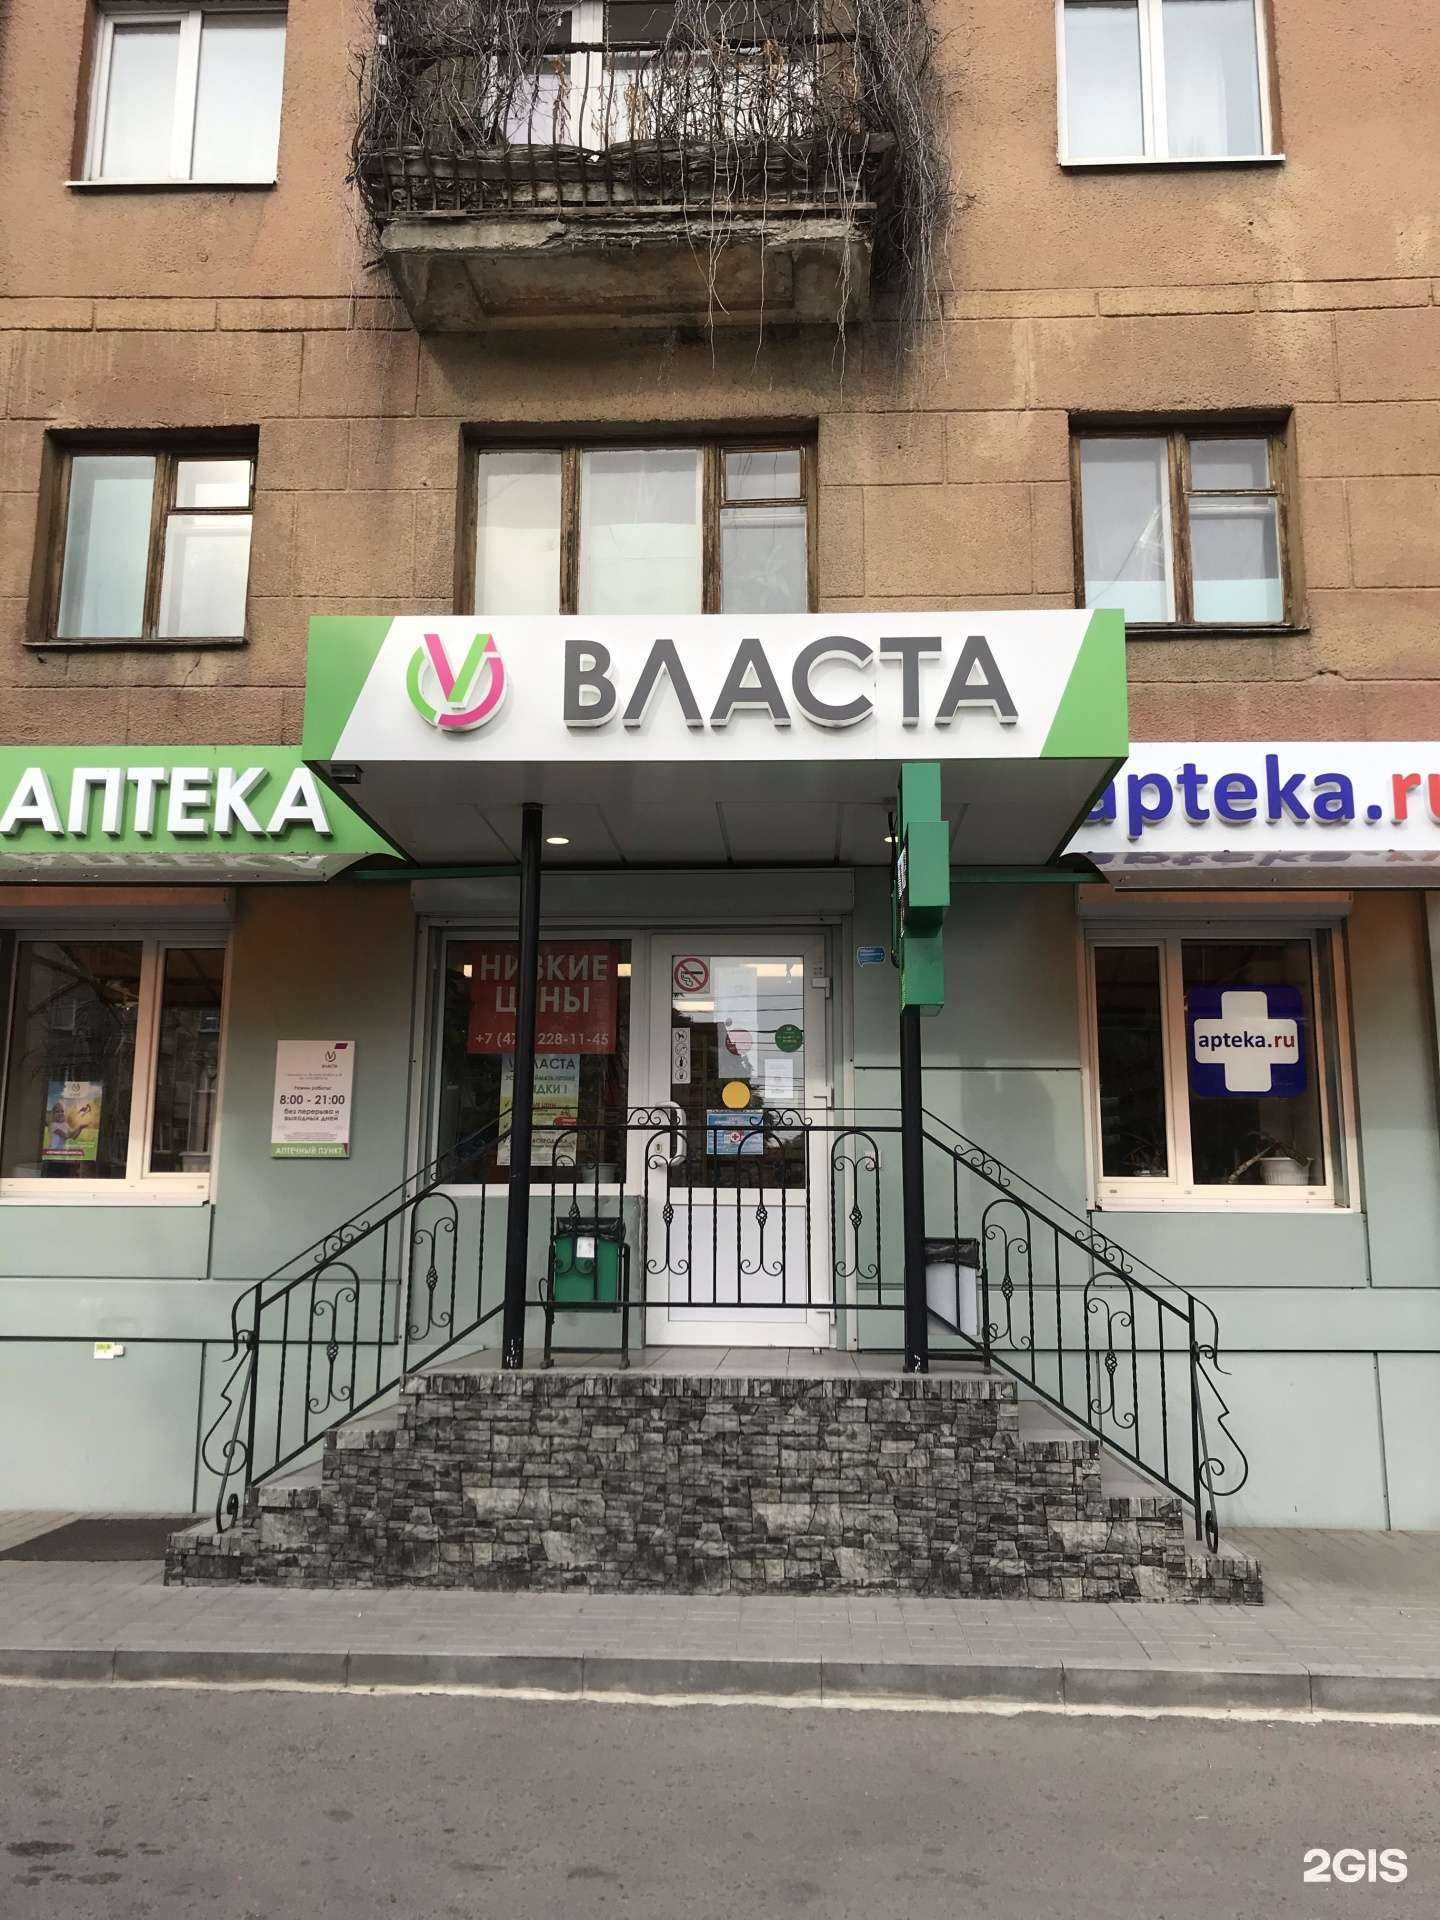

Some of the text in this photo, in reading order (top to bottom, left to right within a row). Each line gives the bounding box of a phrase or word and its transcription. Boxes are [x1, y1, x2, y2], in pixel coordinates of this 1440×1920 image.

[563, 635, 1019, 728] ВЛАСТА
[0, 767, 334, 838] АПТЕКА
[495, 986, 589, 1016] ЦНЫ
[476, 1033, 492, 1044] +7
[538, 1032, 609, 1045] 228-11-45
[1198, 1031, 1295, 1051] apteka.ru
[534, 1058, 575, 1069] АСТА
[280, 1095, 303, 1105] 8:00
[315, 1095, 345, 1105] 21:00
